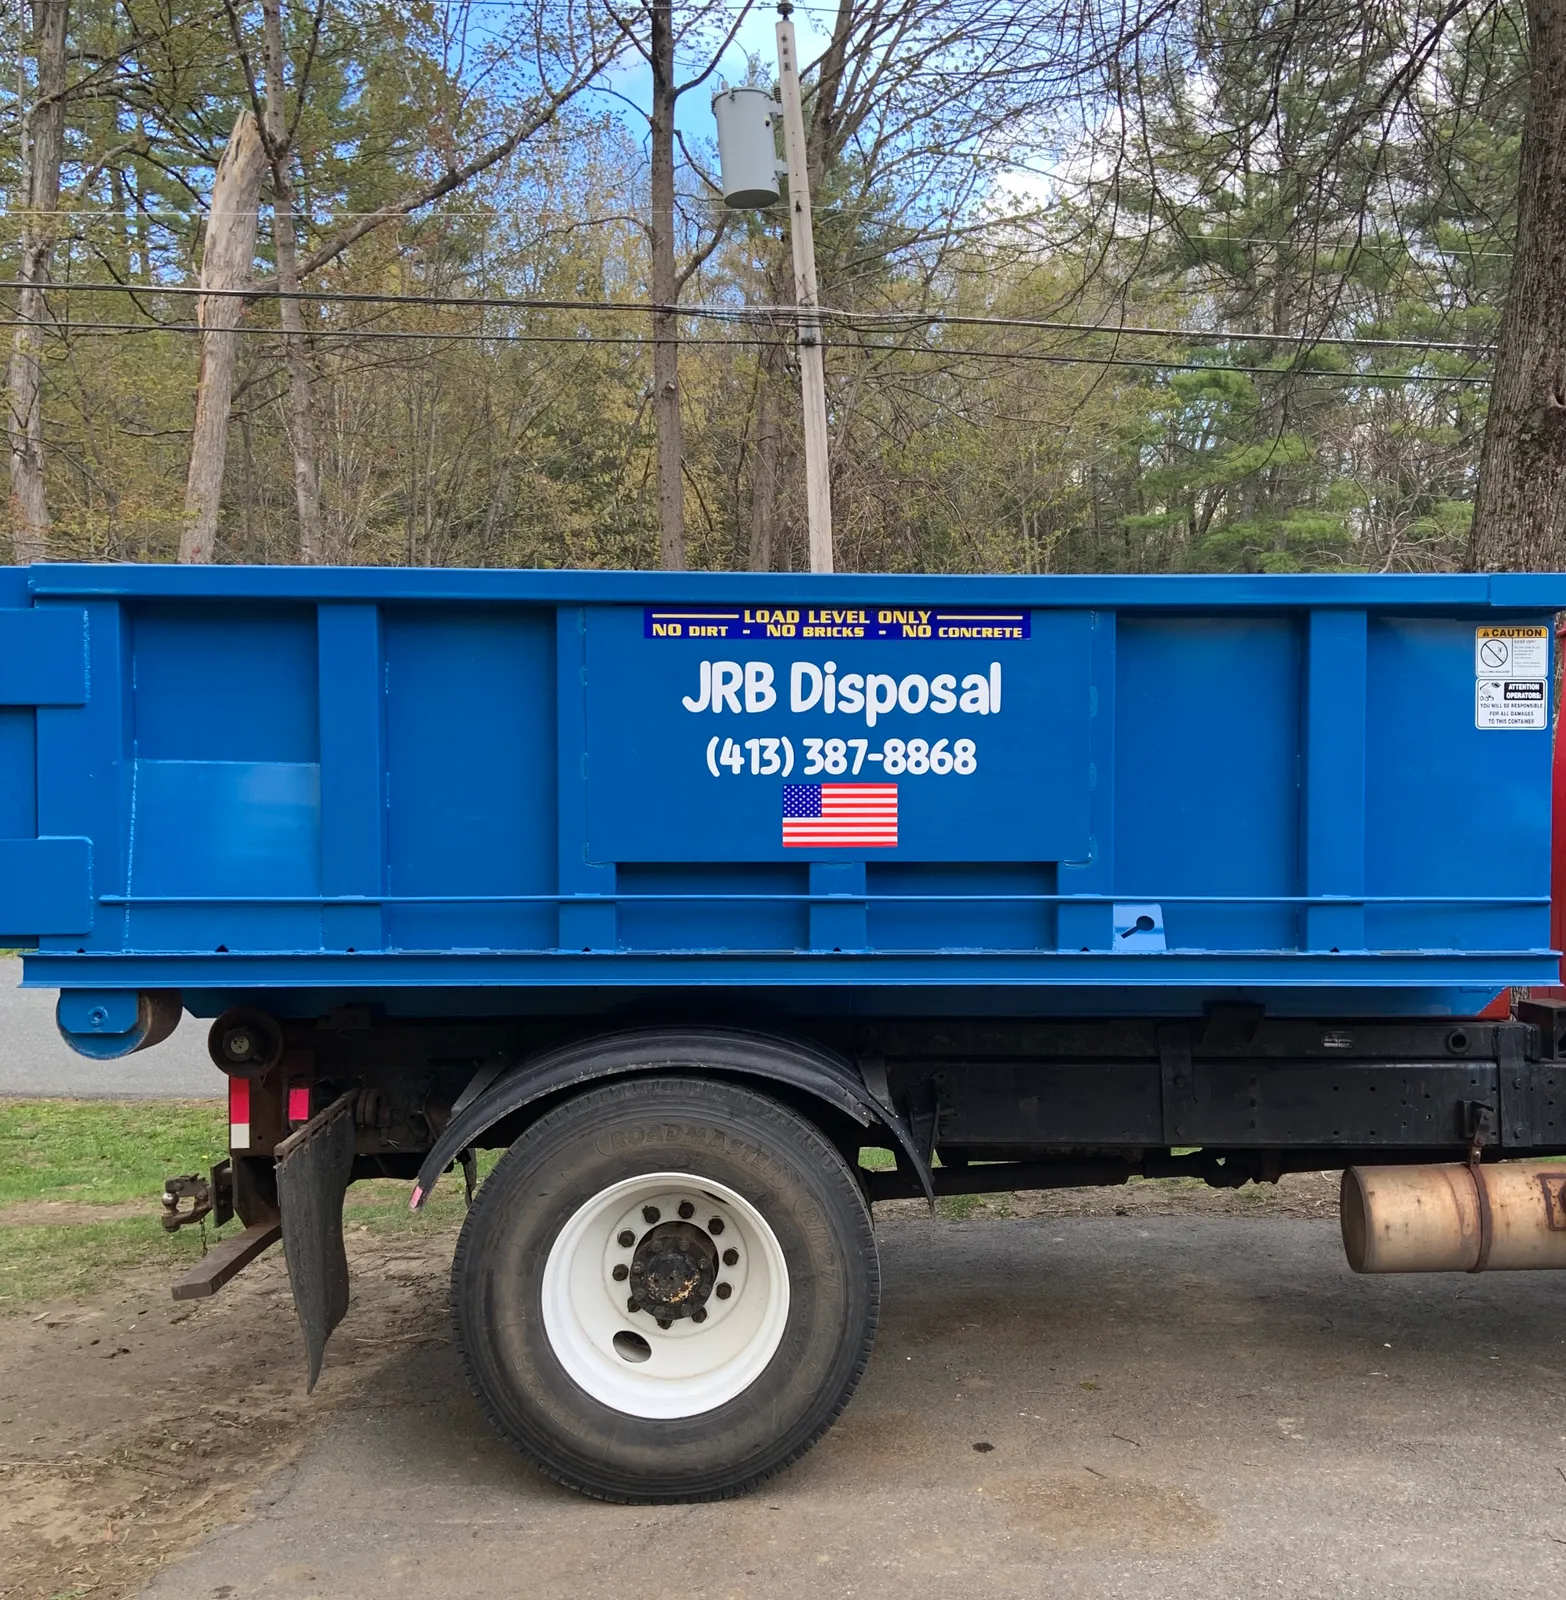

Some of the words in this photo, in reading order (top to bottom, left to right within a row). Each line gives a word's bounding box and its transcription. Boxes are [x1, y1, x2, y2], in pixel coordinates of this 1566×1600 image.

[652, 623, 682, 636] NO
[688, 625, 729, 637] DIRT
[766, 624, 796, 637] NO
[802, 626, 865, 638] BRICKS
[902, 624, 932, 638] NO
[938, 627, 1023, 638] CONCRETE
[744, 610, 800, 624] LOAD
[808, 610, 870, 624] LEVEL
[878, 610, 932, 624] ONLY
[1491, 629, 1542, 637] CAUTION
[682, 660, 776, 714] JRB
[790, 660, 1001, 727] Disposal
[706, 736, 795, 777] (413)
[802, 737, 977, 775] 387-8868
[609, 1123, 785, 1183] ROADMASTER
